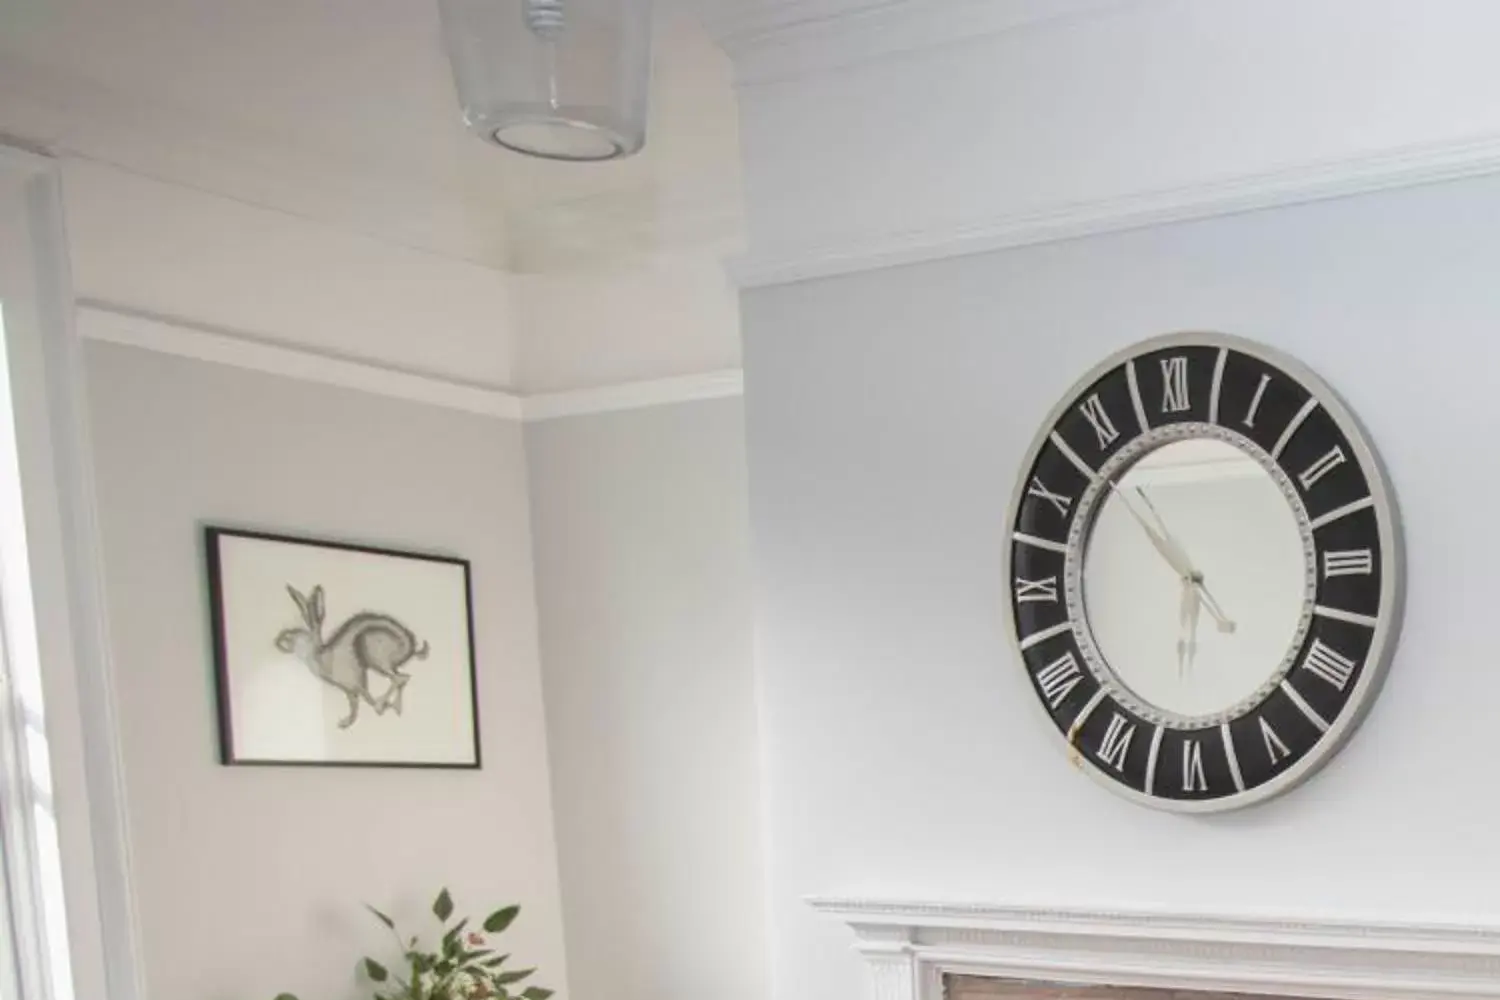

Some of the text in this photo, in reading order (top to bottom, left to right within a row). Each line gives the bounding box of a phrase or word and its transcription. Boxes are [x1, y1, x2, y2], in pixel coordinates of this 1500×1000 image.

[1161, 357, 1190, 412] XII
[1243, 374, 1271, 427] I
[1079, 393, 1120, 450] XI
[1298, 445, 1346, 491] II
[1028, 477, 1072, 515] X
[1324, 549, 1372, 577] III
[1016, 576, 1057, 603] IX
[1036, 651, 1085, 708] VIII
[1302, 638, 1355, 691] IIII
[1097, 713, 1136, 771] VII
[1183, 740, 1208, 791] VI
[1258, 715, 1290, 765] V
